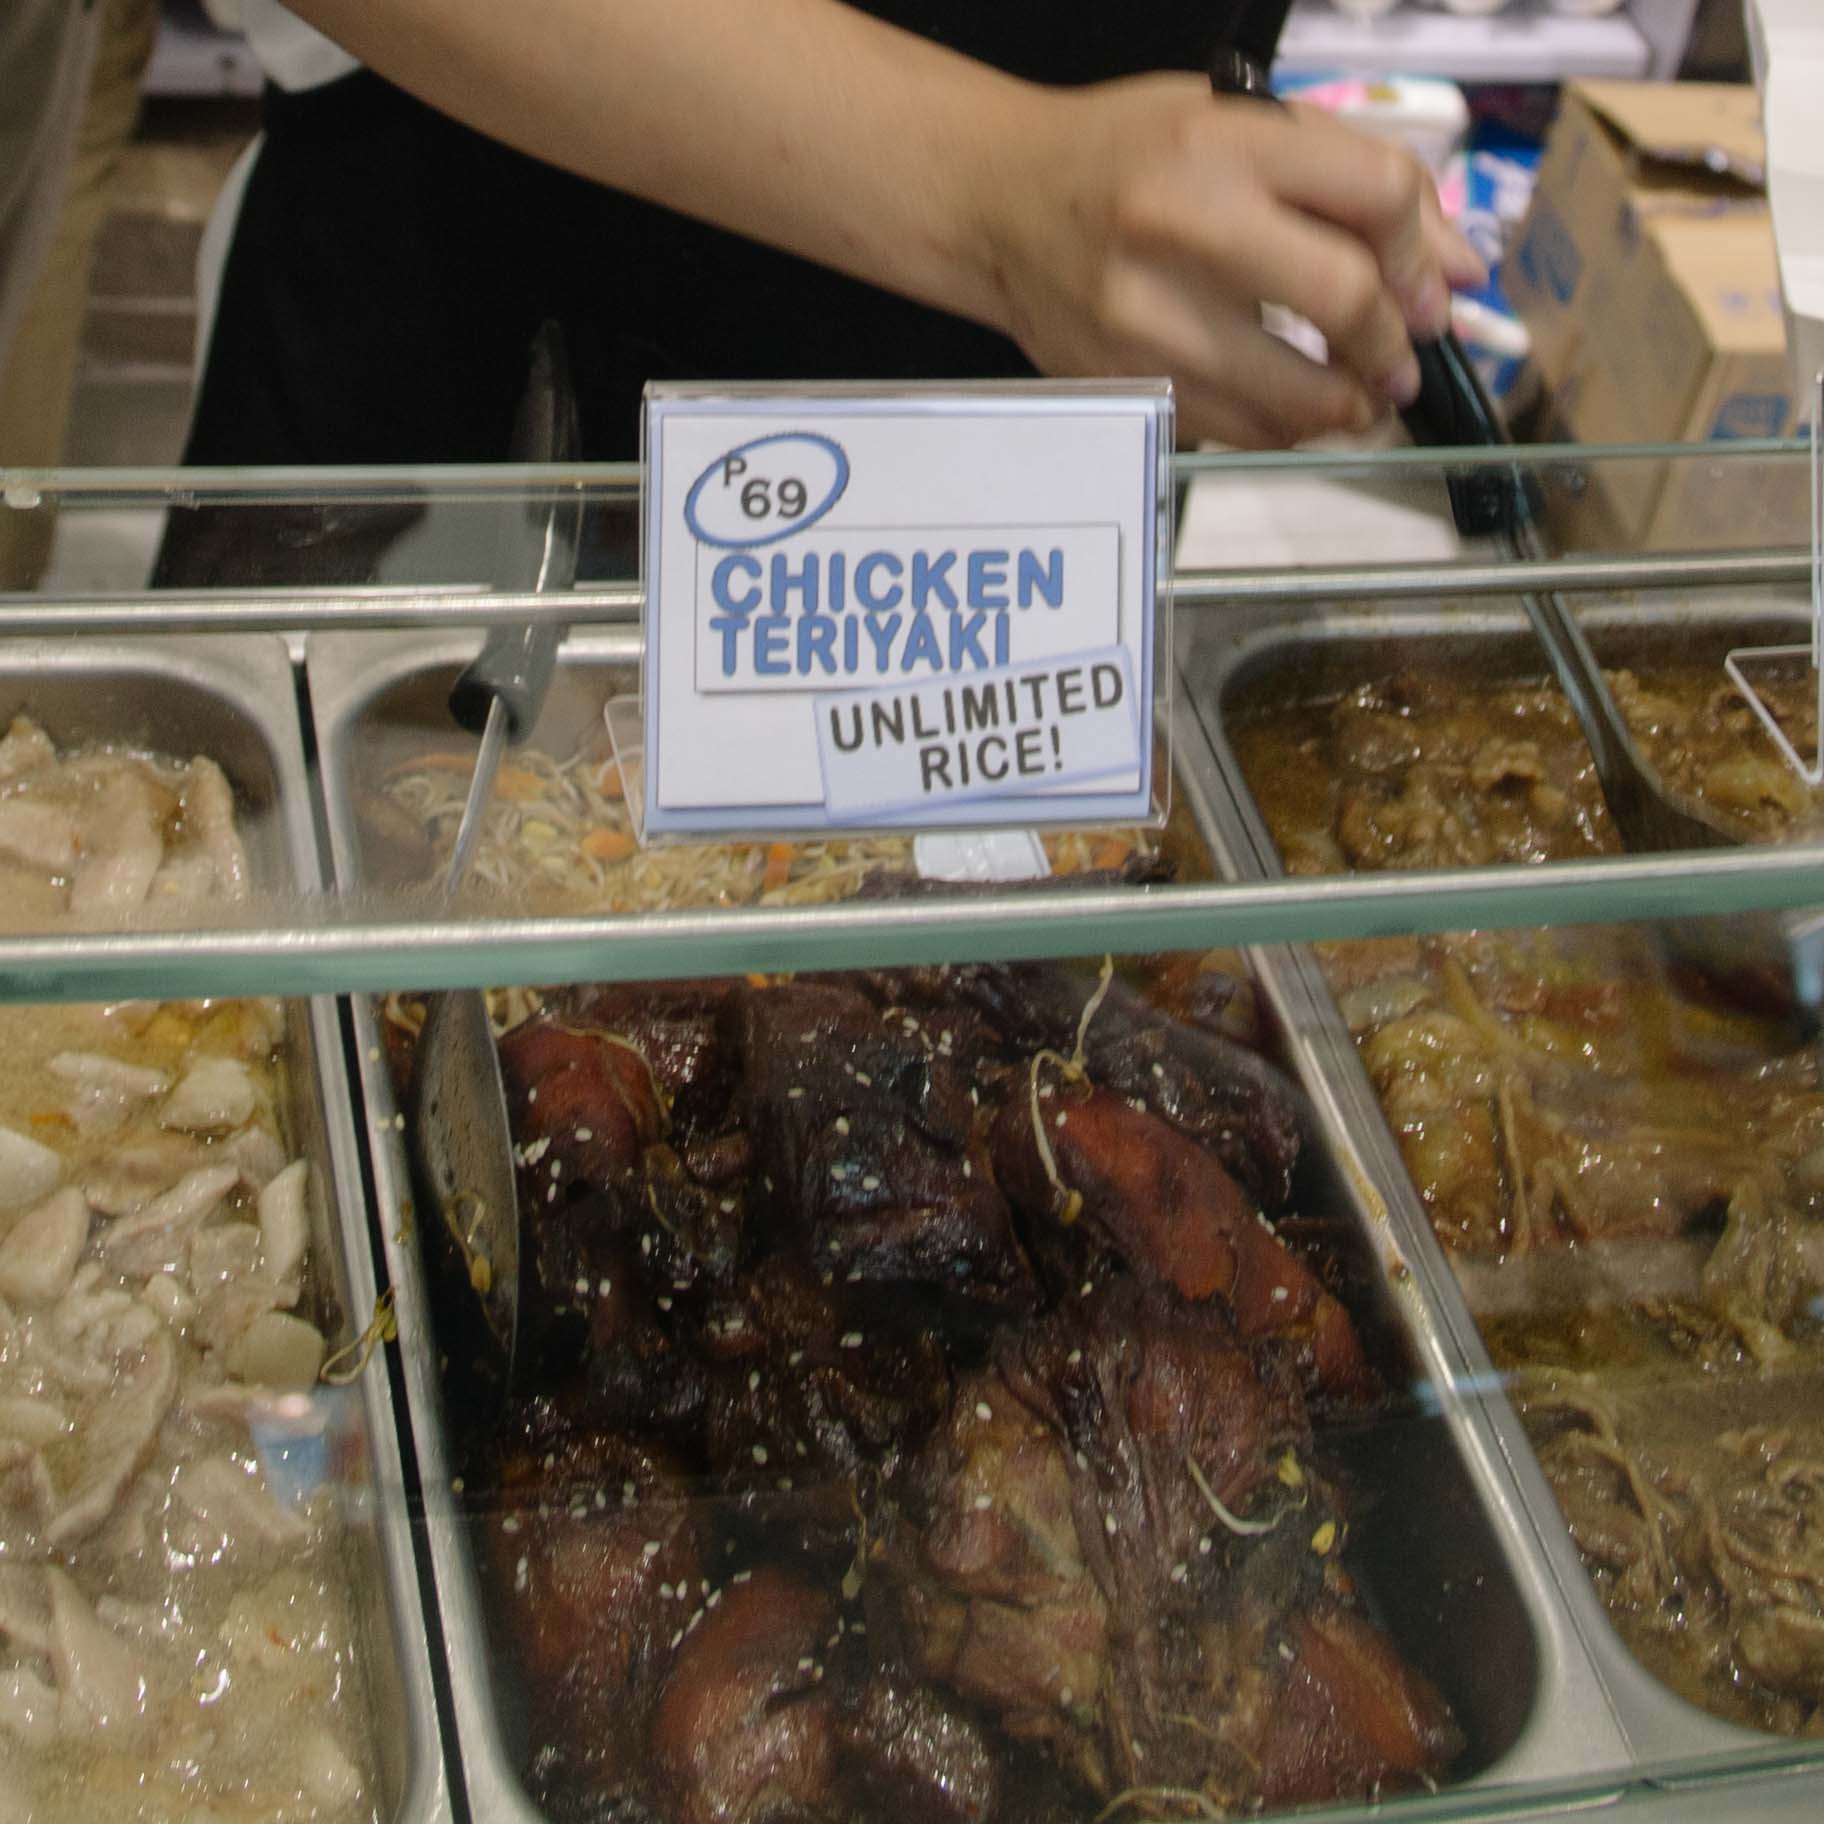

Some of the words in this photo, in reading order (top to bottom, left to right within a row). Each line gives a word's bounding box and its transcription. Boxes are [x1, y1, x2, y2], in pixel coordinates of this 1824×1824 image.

[711, 549, 1065, 616] CHICKEN
[709, 611, 1011, 676] TERIYAKI
[829, 663, 1125, 753] UNLIMITED
[919, 725, 1064, 793] RICE!
